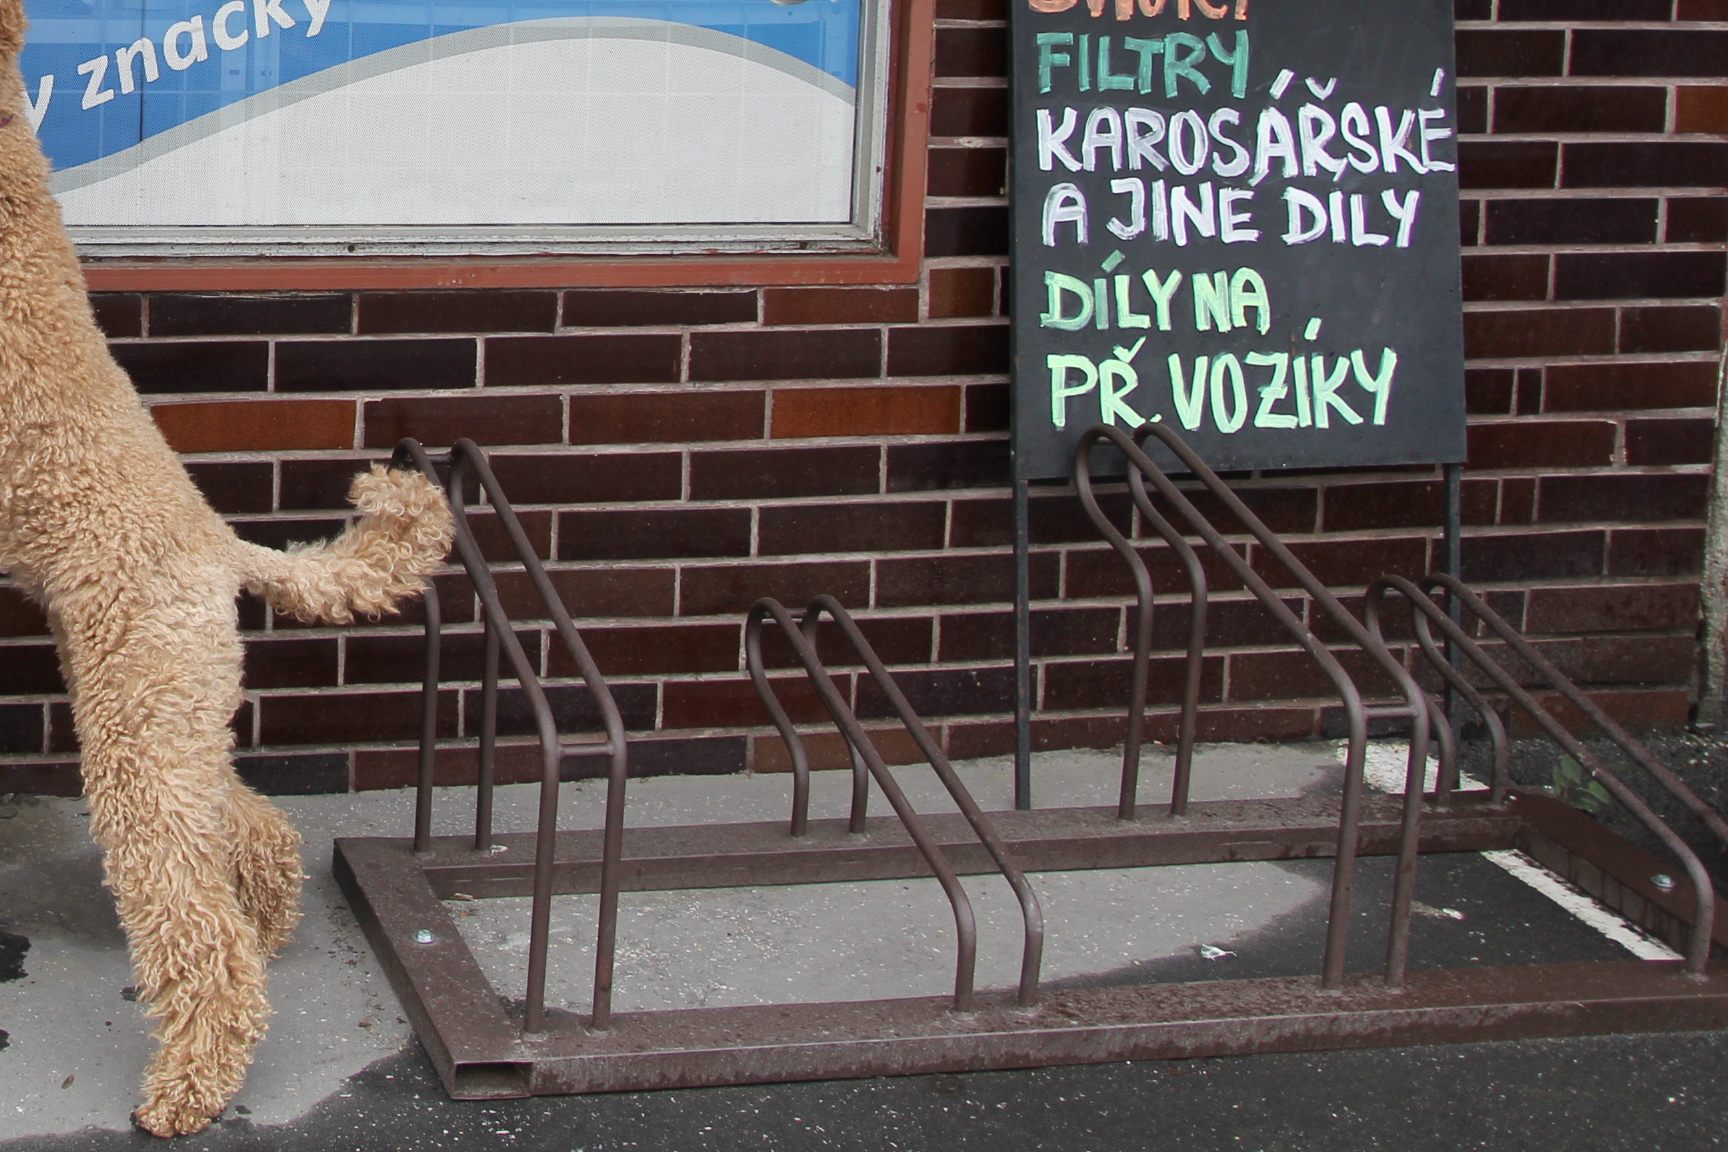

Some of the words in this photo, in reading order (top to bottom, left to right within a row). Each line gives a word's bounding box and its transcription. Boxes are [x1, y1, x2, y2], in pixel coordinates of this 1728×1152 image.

[1035, 29, 1250, 99] FILTRY
[1036, 67, 1456, 179] KAROSÁŘSKÉ
[1041, 181, 1089, 247] A
[1039, 249, 1183, 332] DÍLY
[1192, 266, 1271, 336] NA
[1046, 335, 1162, 430] PŘ.
[1167, 317, 1398, 434] VOZÍKY
